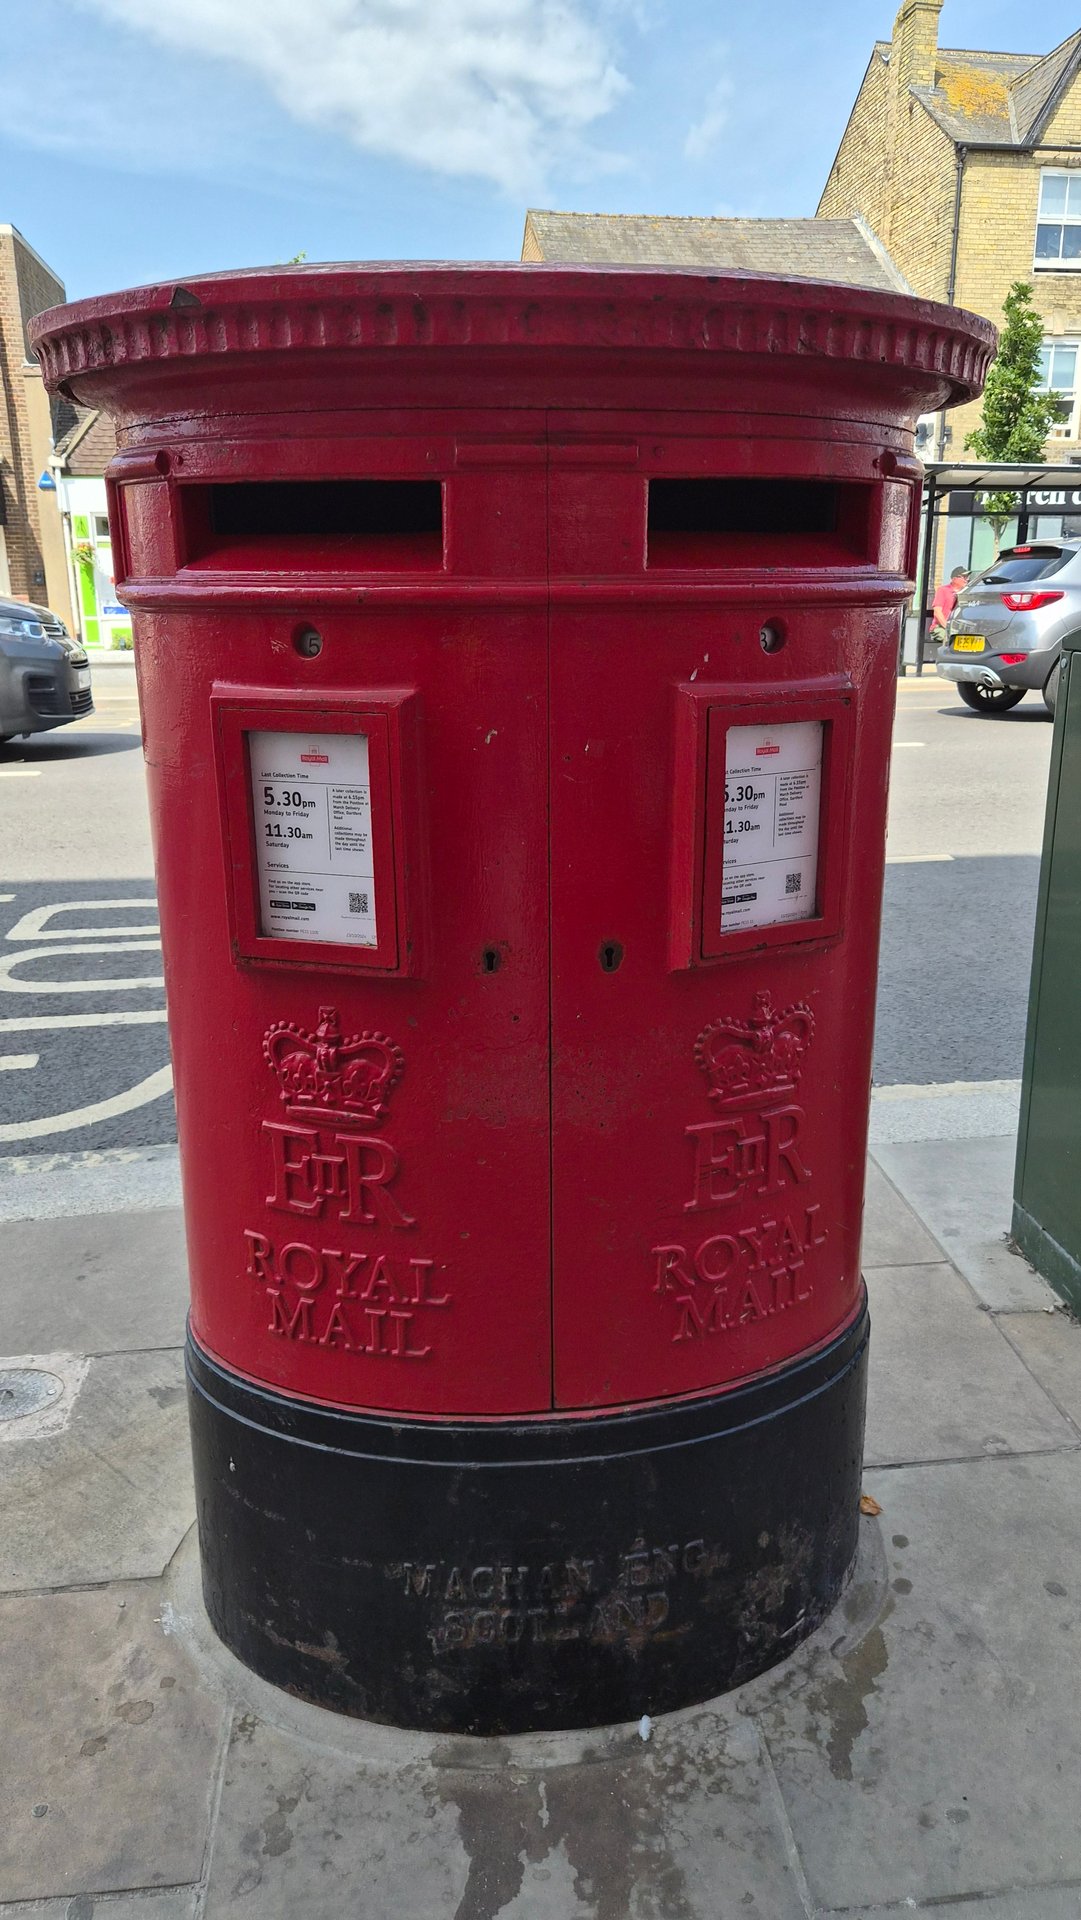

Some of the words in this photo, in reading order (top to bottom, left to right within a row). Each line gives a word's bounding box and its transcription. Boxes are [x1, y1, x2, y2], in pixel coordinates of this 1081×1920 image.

[309, 637, 320, 656] 5
[264, 786, 316, 809] 5.30pm
[264, 809, 284, 817] Monday
[265, 823, 313, 839] 11.30am
[265, 841, 289, 849] Saturday
[724, 820, 760, 834] 1.30am
[243, 1229, 452, 1305] ROYAL
[651, 1204, 829, 1292] ROYAL
[671, 1260, 814, 1343] MAIL
[265, 1288, 432, 1357] MAIL
[403, 1561, 596, 1601] MACHAN
[621, 1538, 705, 1588] ENG
[442, 1591, 670, 1645] SCOTLAND
